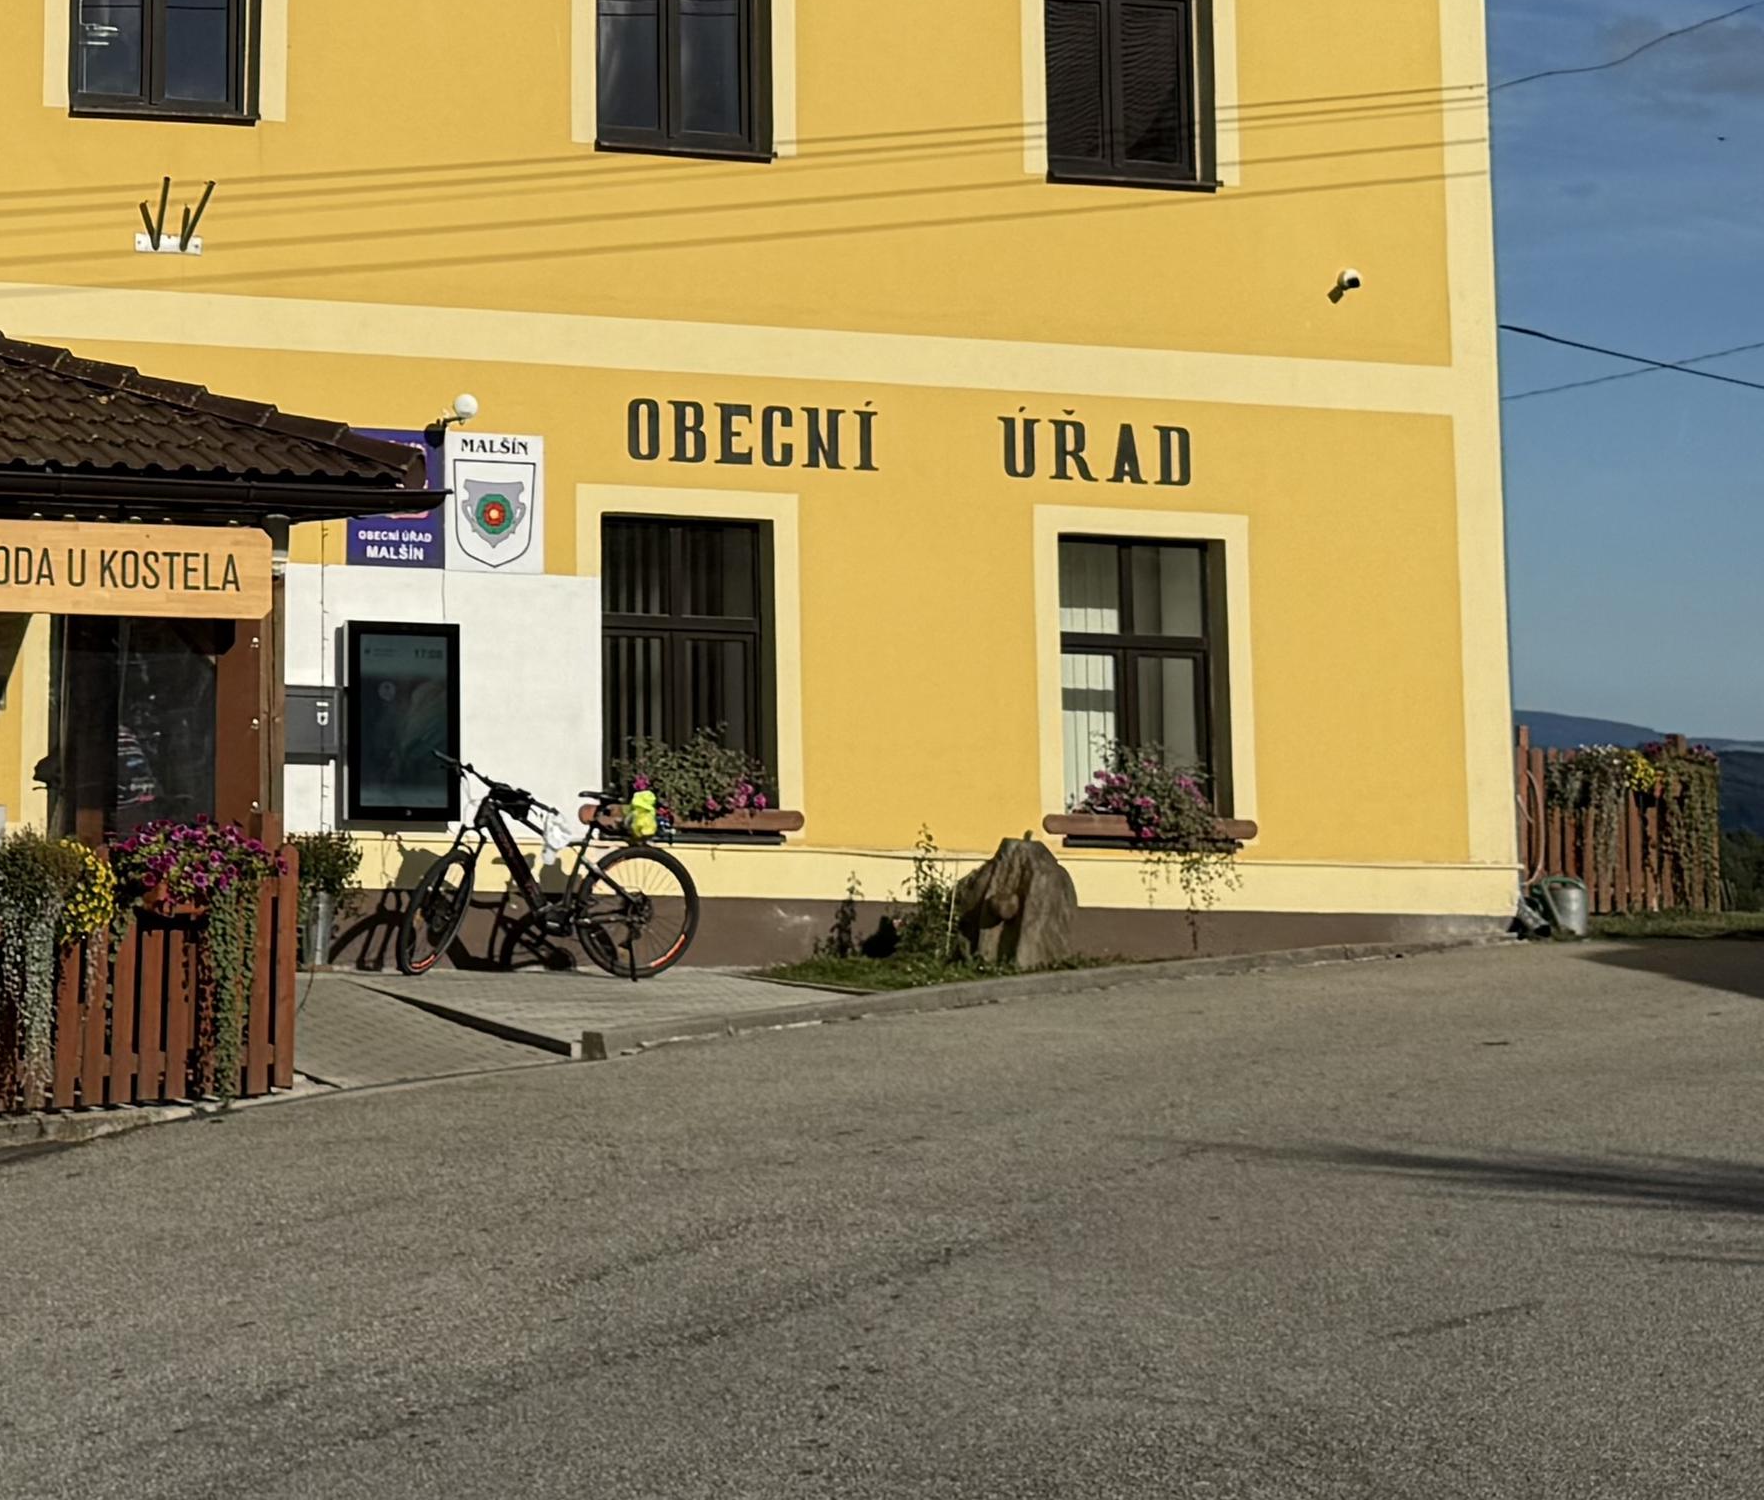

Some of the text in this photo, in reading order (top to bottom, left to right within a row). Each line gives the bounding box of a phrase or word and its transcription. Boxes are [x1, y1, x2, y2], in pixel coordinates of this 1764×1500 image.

[461, 437, 528, 455] MALŠÍN
[627, 398, 1191, 486] OBECNÍ ÚŘAD
[358, 529, 433, 543] OBECNÍ ÚŘAD
[366, 542, 425, 561] MALŠÍN
[68, 549, 87, 587] U
[99, 549, 241, 592] KOSTELA
